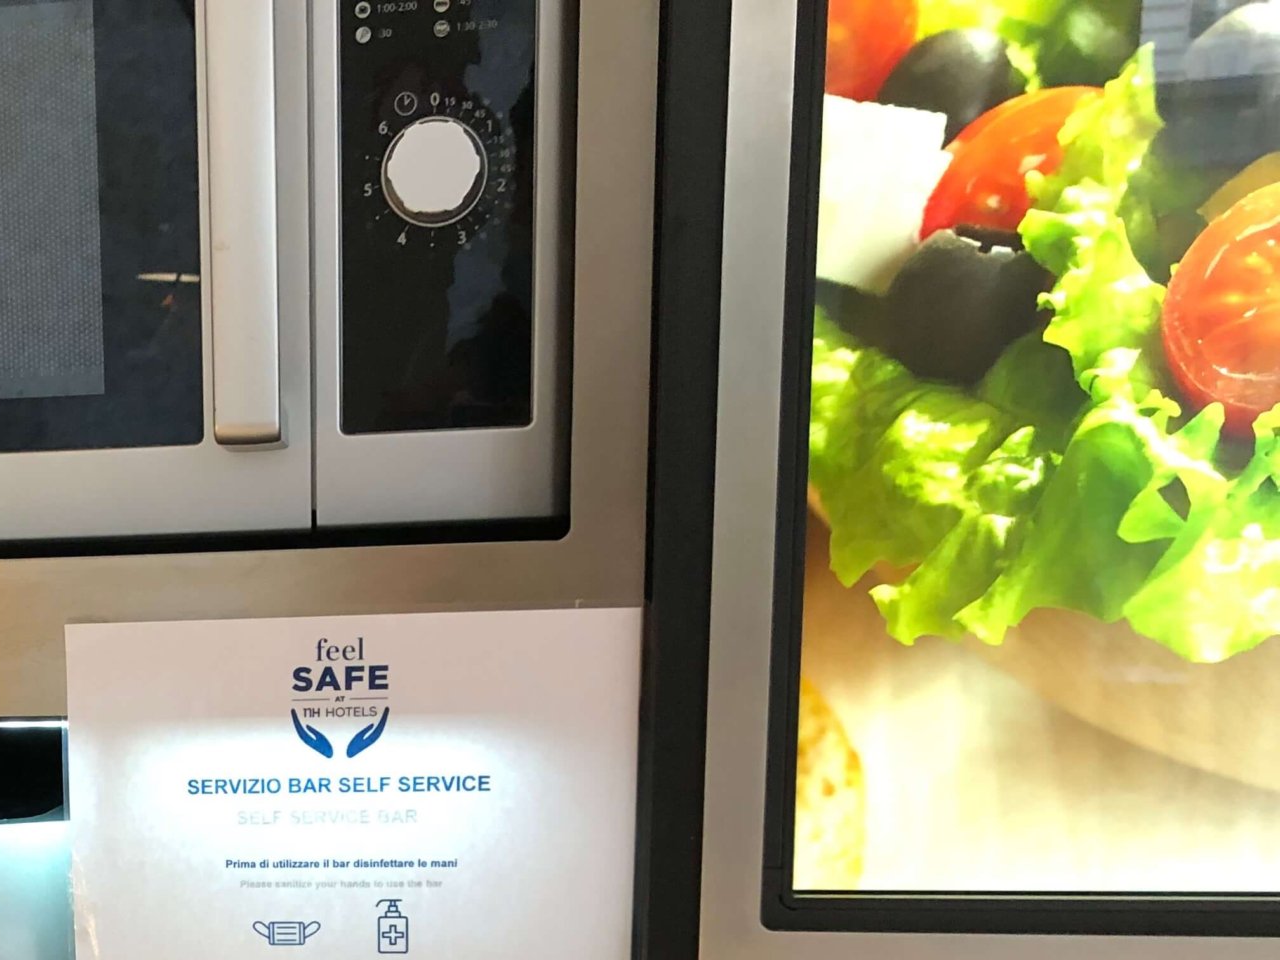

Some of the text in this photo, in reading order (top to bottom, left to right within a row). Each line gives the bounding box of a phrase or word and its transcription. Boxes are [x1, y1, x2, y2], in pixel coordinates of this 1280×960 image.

[430, 92, 440, 106] 0
[378, 121, 388, 135] 6
[486, 119, 493, 132] 1
[364, 184, 372, 196] 5
[497, 179, 506, 192] 2
[397, 232, 407, 245] 4
[458, 232, 467, 244] 3
[316, 637, 364, 661] feel
[292, 665, 389, 692] SAFE
[325, 706, 378, 717] HOTELS
[188, 775, 491, 795] SERVIZIO BAR SELF SERVICE
[237, 809, 418, 825] SELF SERVICE BAR
[225, 858, 458, 869] Prima di utilizzare il bar disinfettare le mani
[240, 879, 272, 889] Please
